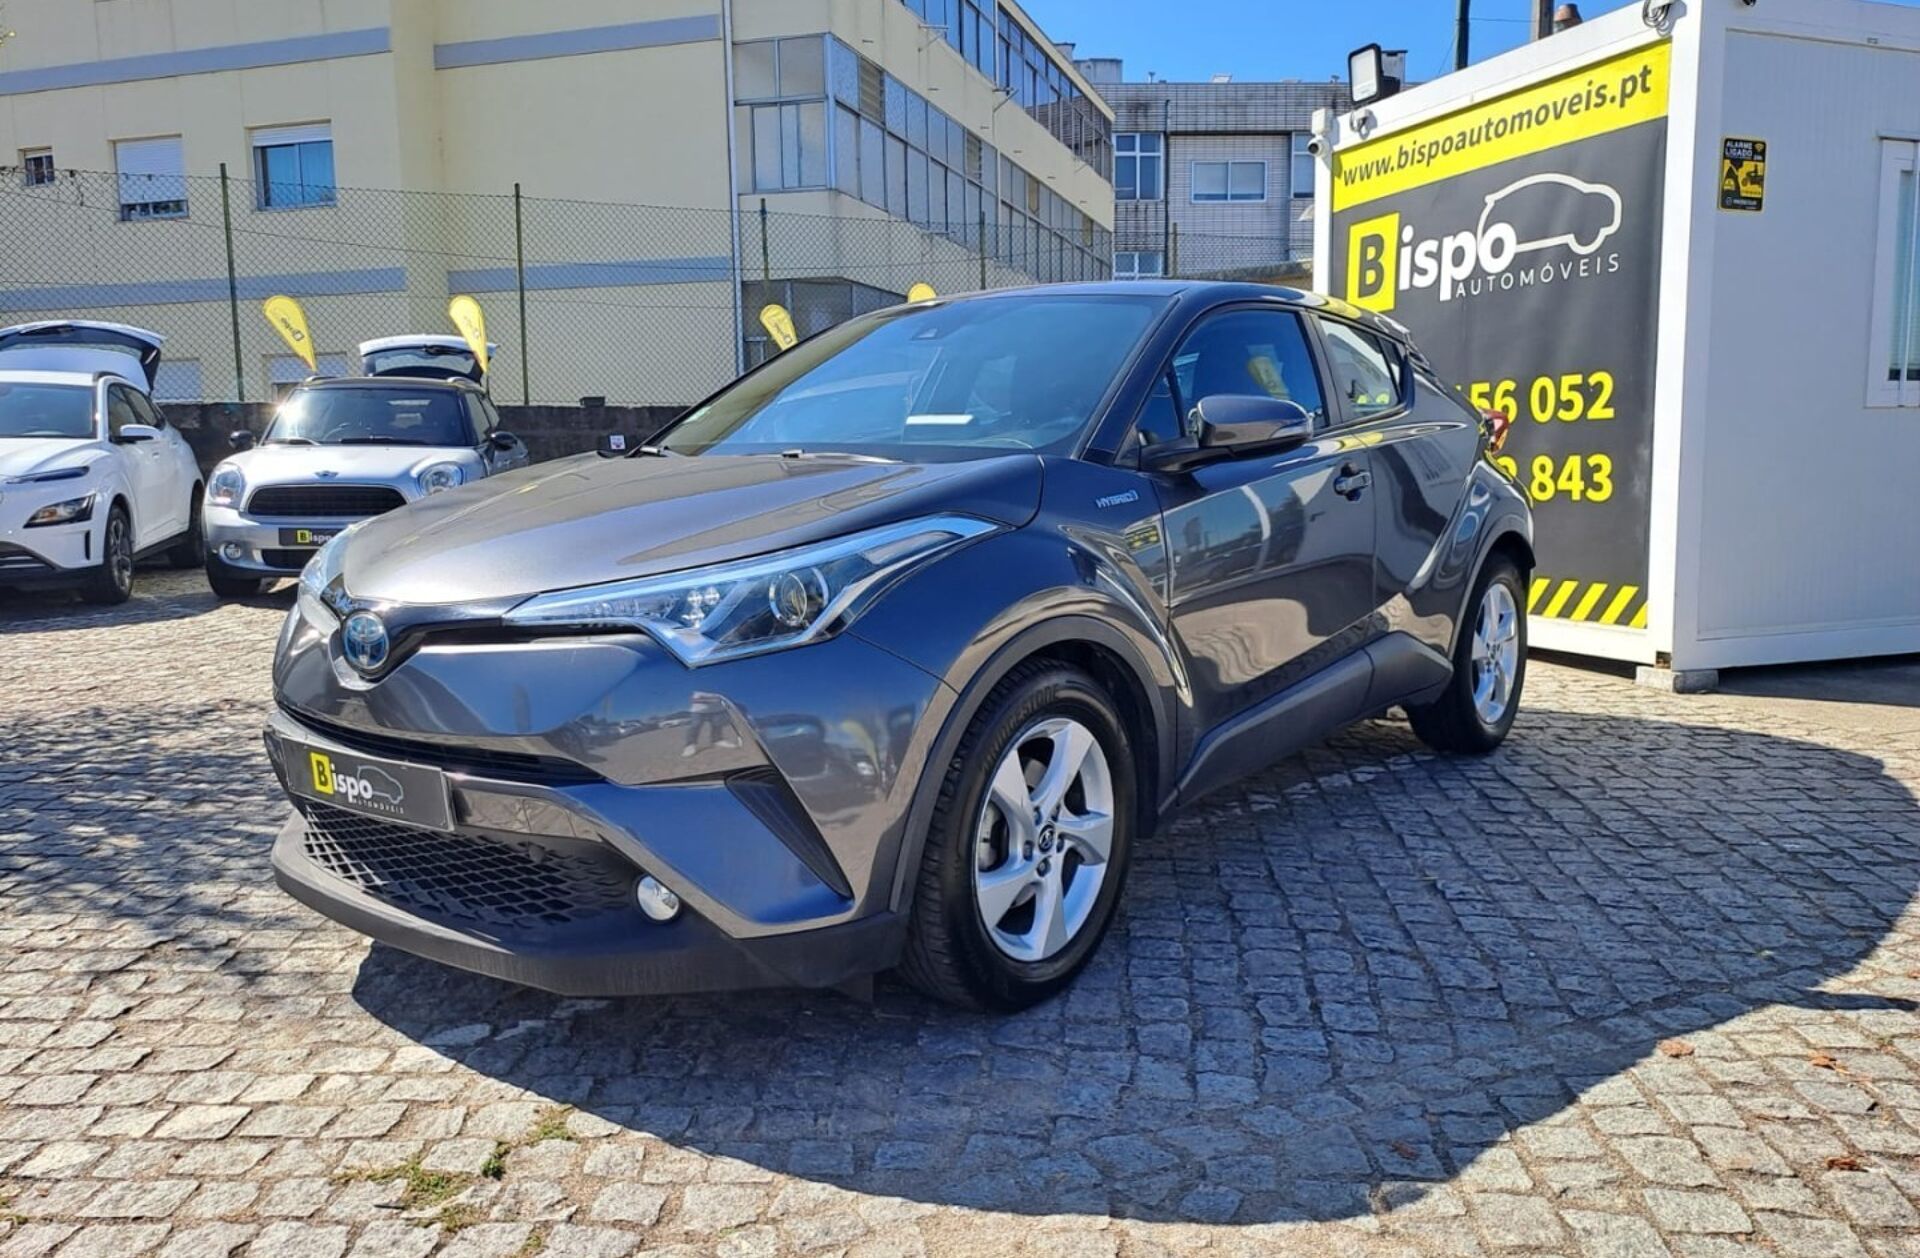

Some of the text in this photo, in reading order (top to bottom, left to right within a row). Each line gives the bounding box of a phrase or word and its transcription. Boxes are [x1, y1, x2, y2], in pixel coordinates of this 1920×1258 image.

[1343, 65, 1652, 187] www.bispoautomoveis.pt
[1356, 222, 1518, 301] Bispo
[1456, 253, 1620, 298] AUTOMÓVEIS
[1456, 371, 1615, 424] 56 052
[1530, 453, 1613, 502] 843
[315, 759, 373, 803] Bispo
